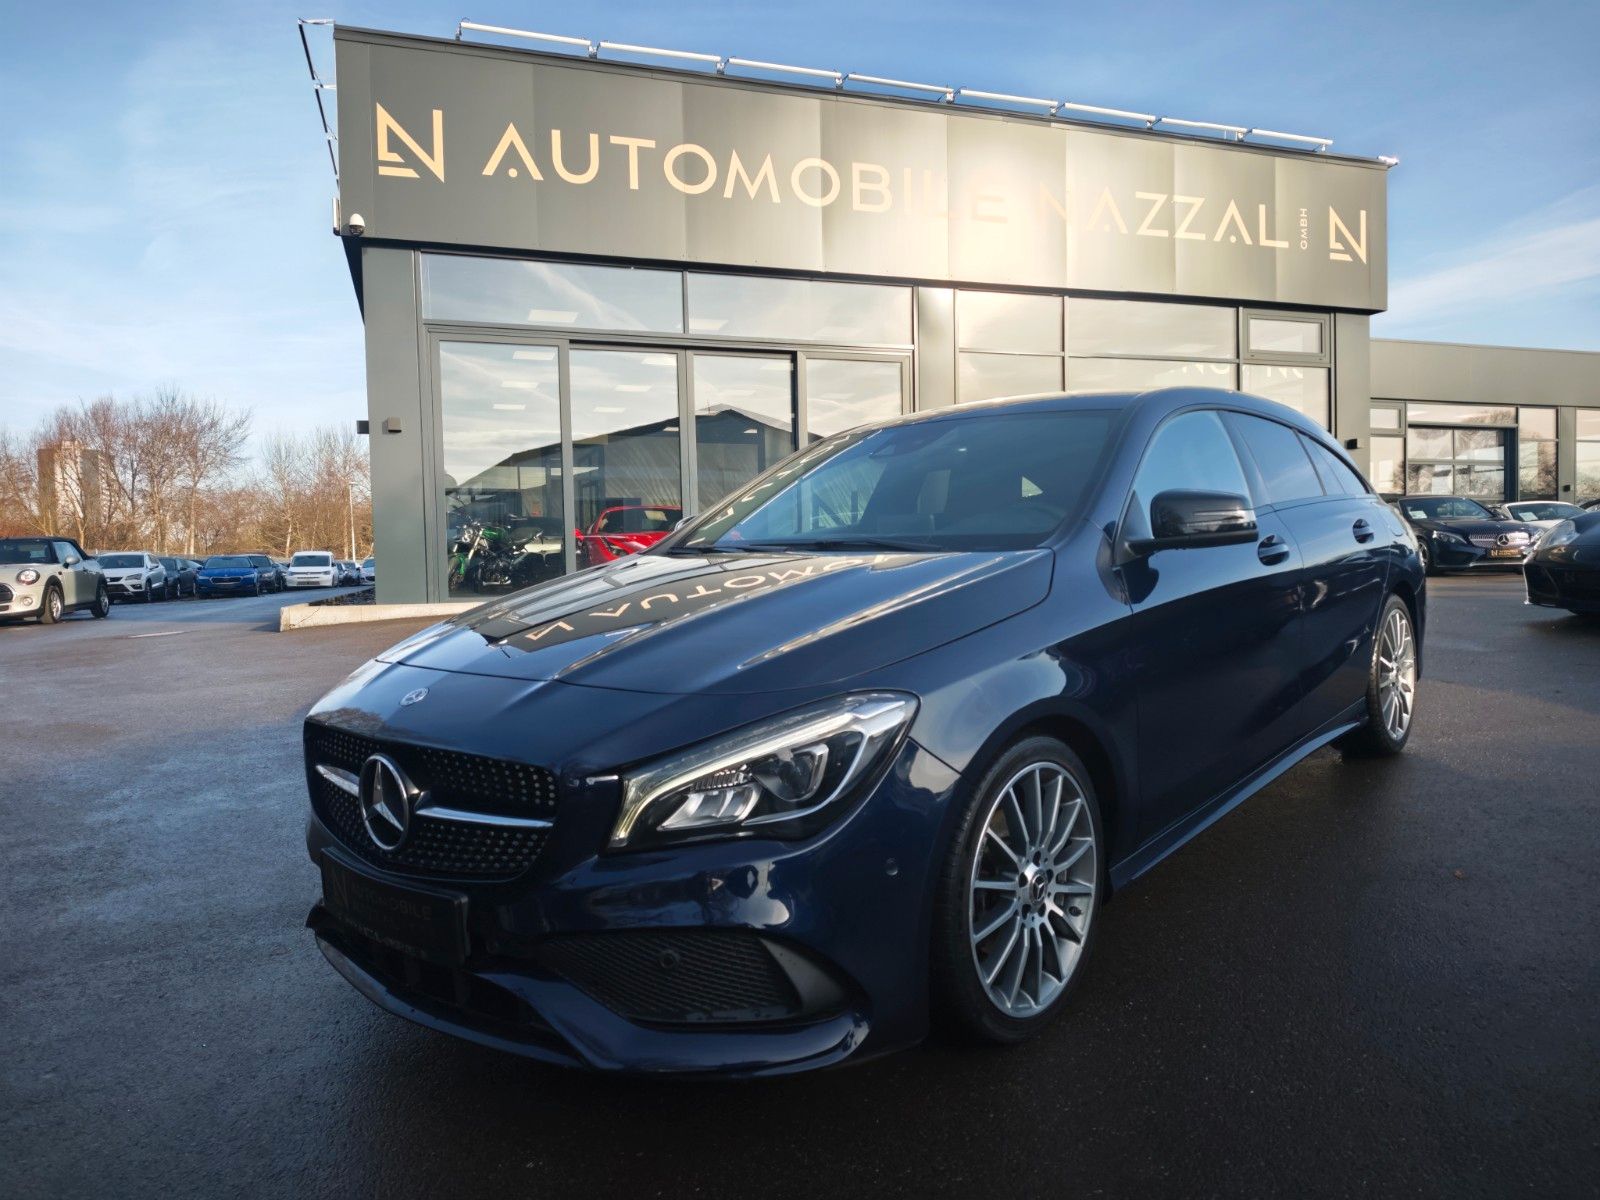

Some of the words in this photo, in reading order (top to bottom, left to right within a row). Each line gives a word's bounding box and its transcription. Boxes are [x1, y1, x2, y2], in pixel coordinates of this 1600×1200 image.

[482, 122, 1008, 224] AUTOMOBILE
[1038, 181, 1289, 249] NAZZAL
[1299, 207, 1308, 250] GMBH
